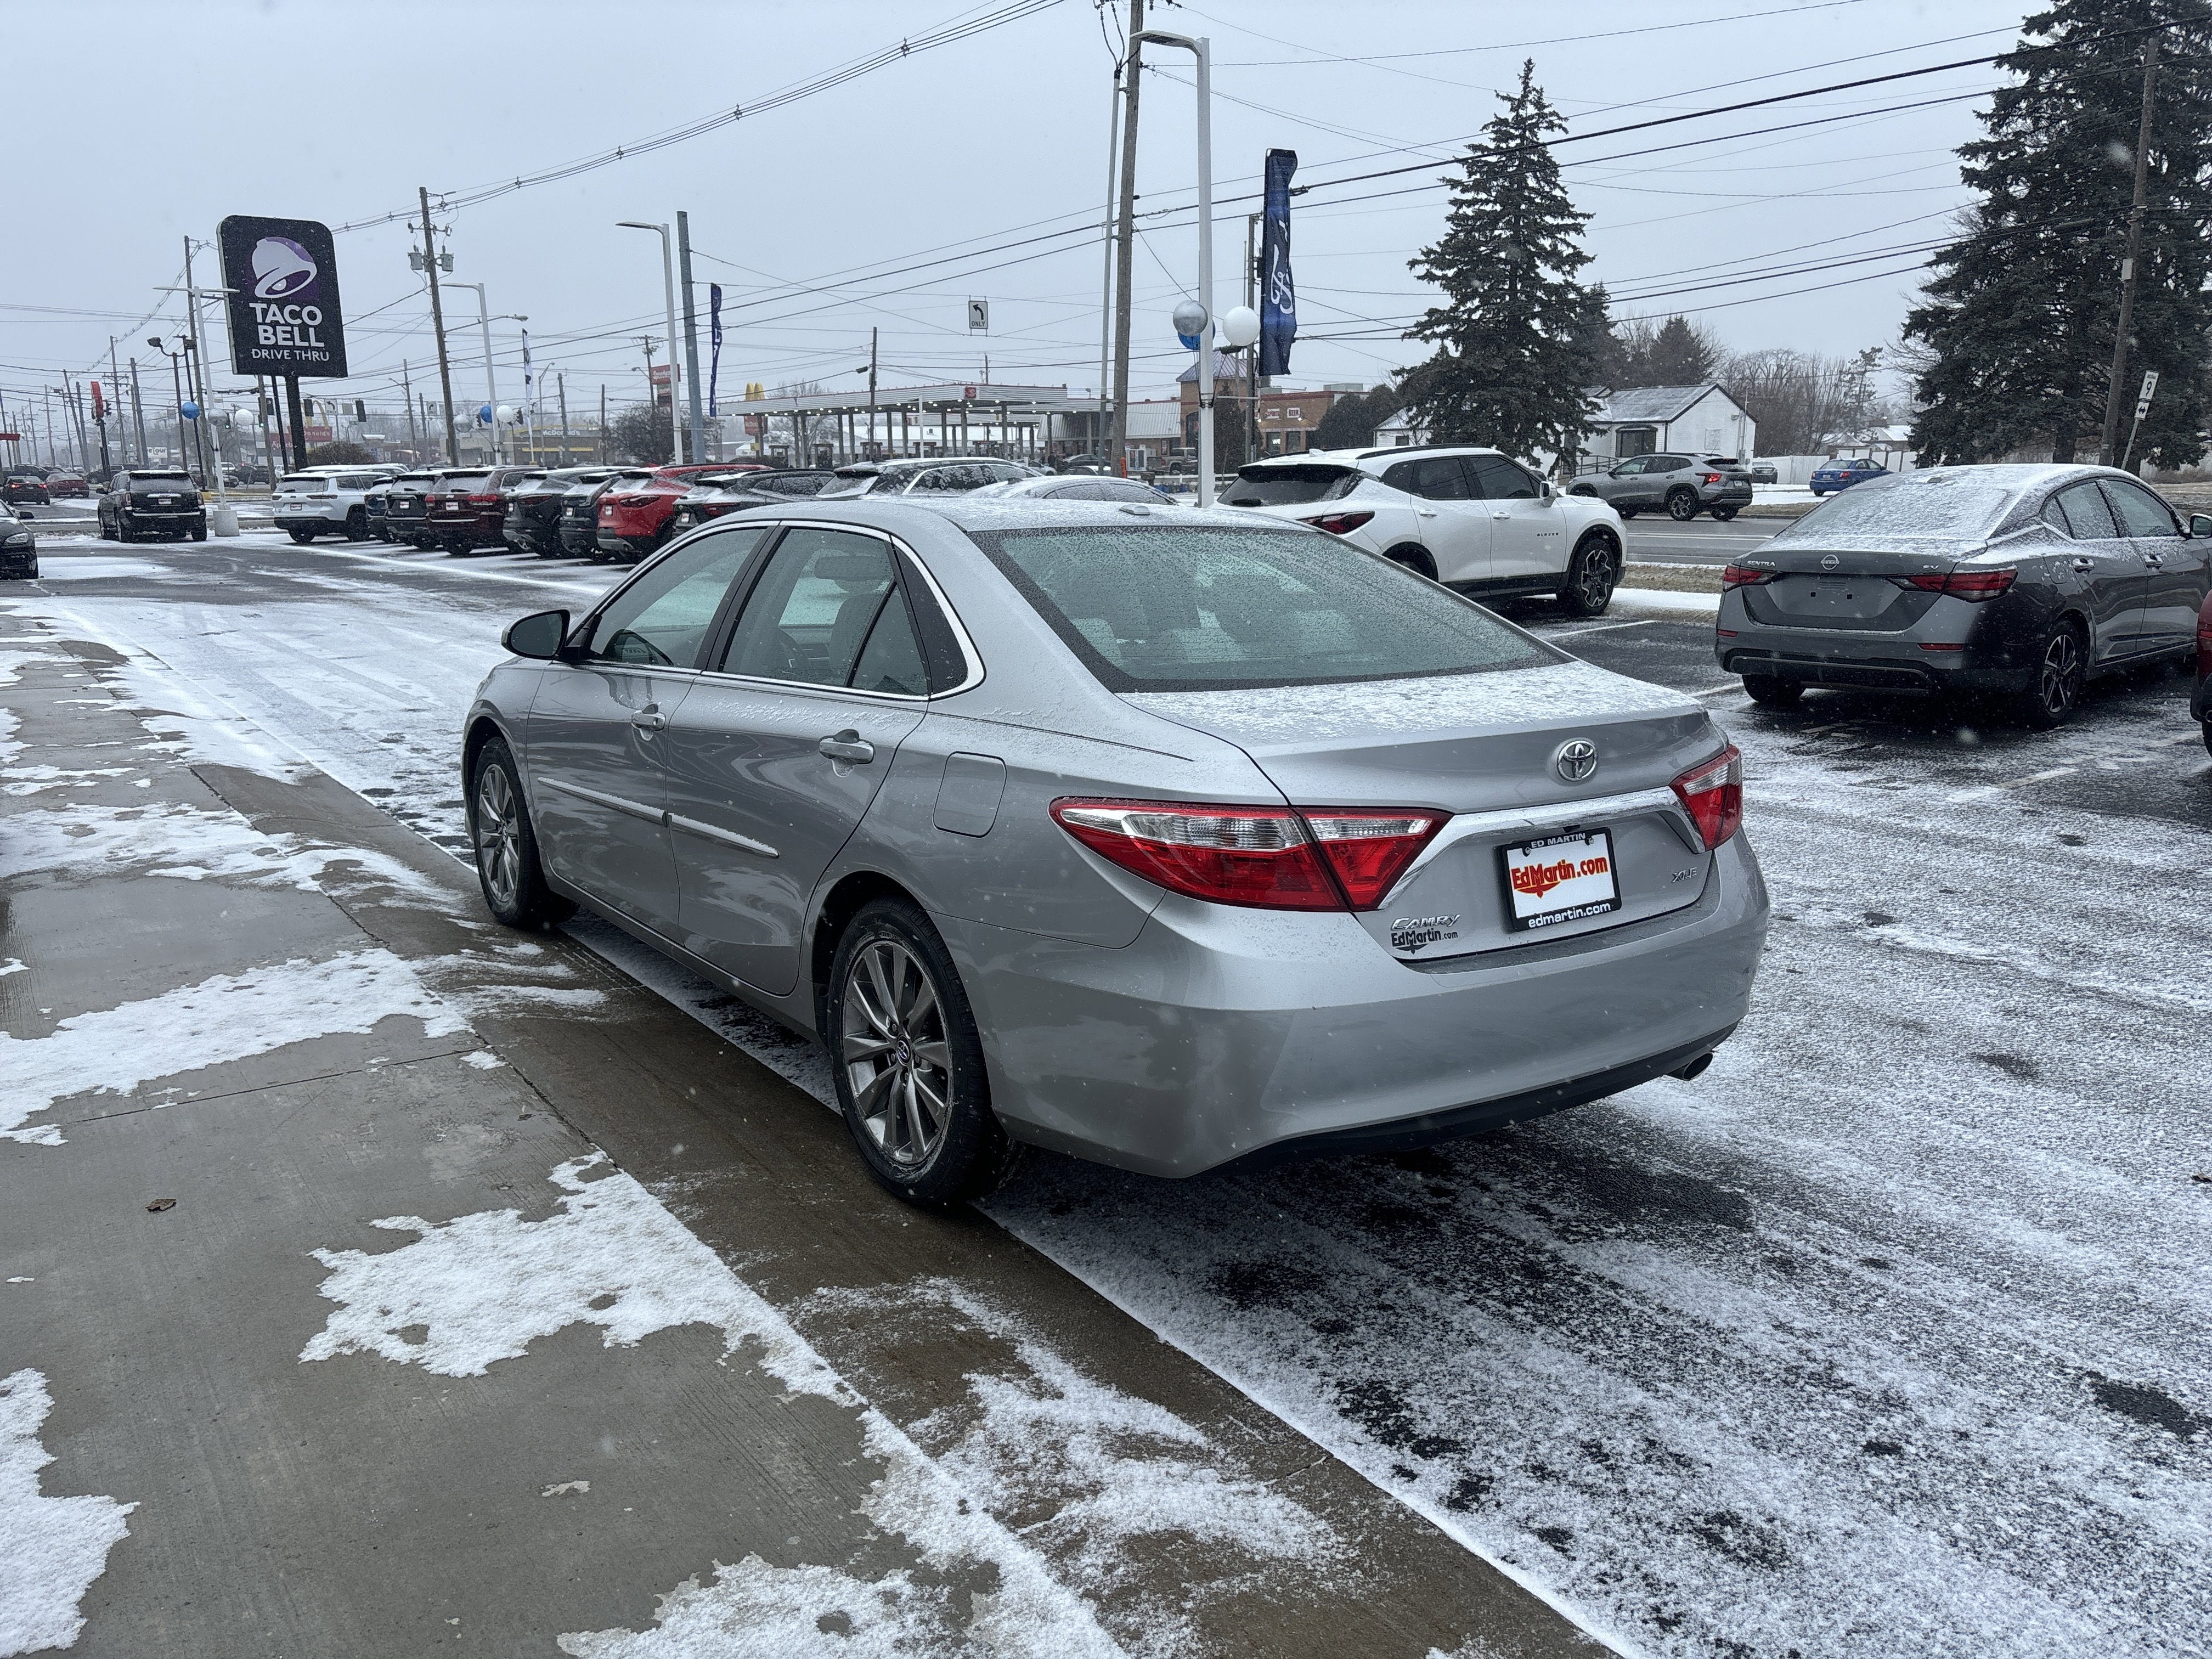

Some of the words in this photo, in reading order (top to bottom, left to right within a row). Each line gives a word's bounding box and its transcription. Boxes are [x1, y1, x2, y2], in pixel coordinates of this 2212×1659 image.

[249, 302, 323, 325] TACO
[257, 325, 325, 347] BELL
[251, 348, 291, 360] DRIVE
[294, 349, 329, 362] THRU
[2145, 381, 2152, 397] 9
[1531, 840, 1545, 849] ED
[1547, 832, 1586, 846] MARTIN
[1510, 856, 1609, 890] EdMartin.com
[1671, 867, 1698, 883] XLE
[1391, 913, 1462, 930] CAMRY
[1528, 902, 1611, 928] edmartin.com
[1391, 927, 1459, 947] EdMartin.com
